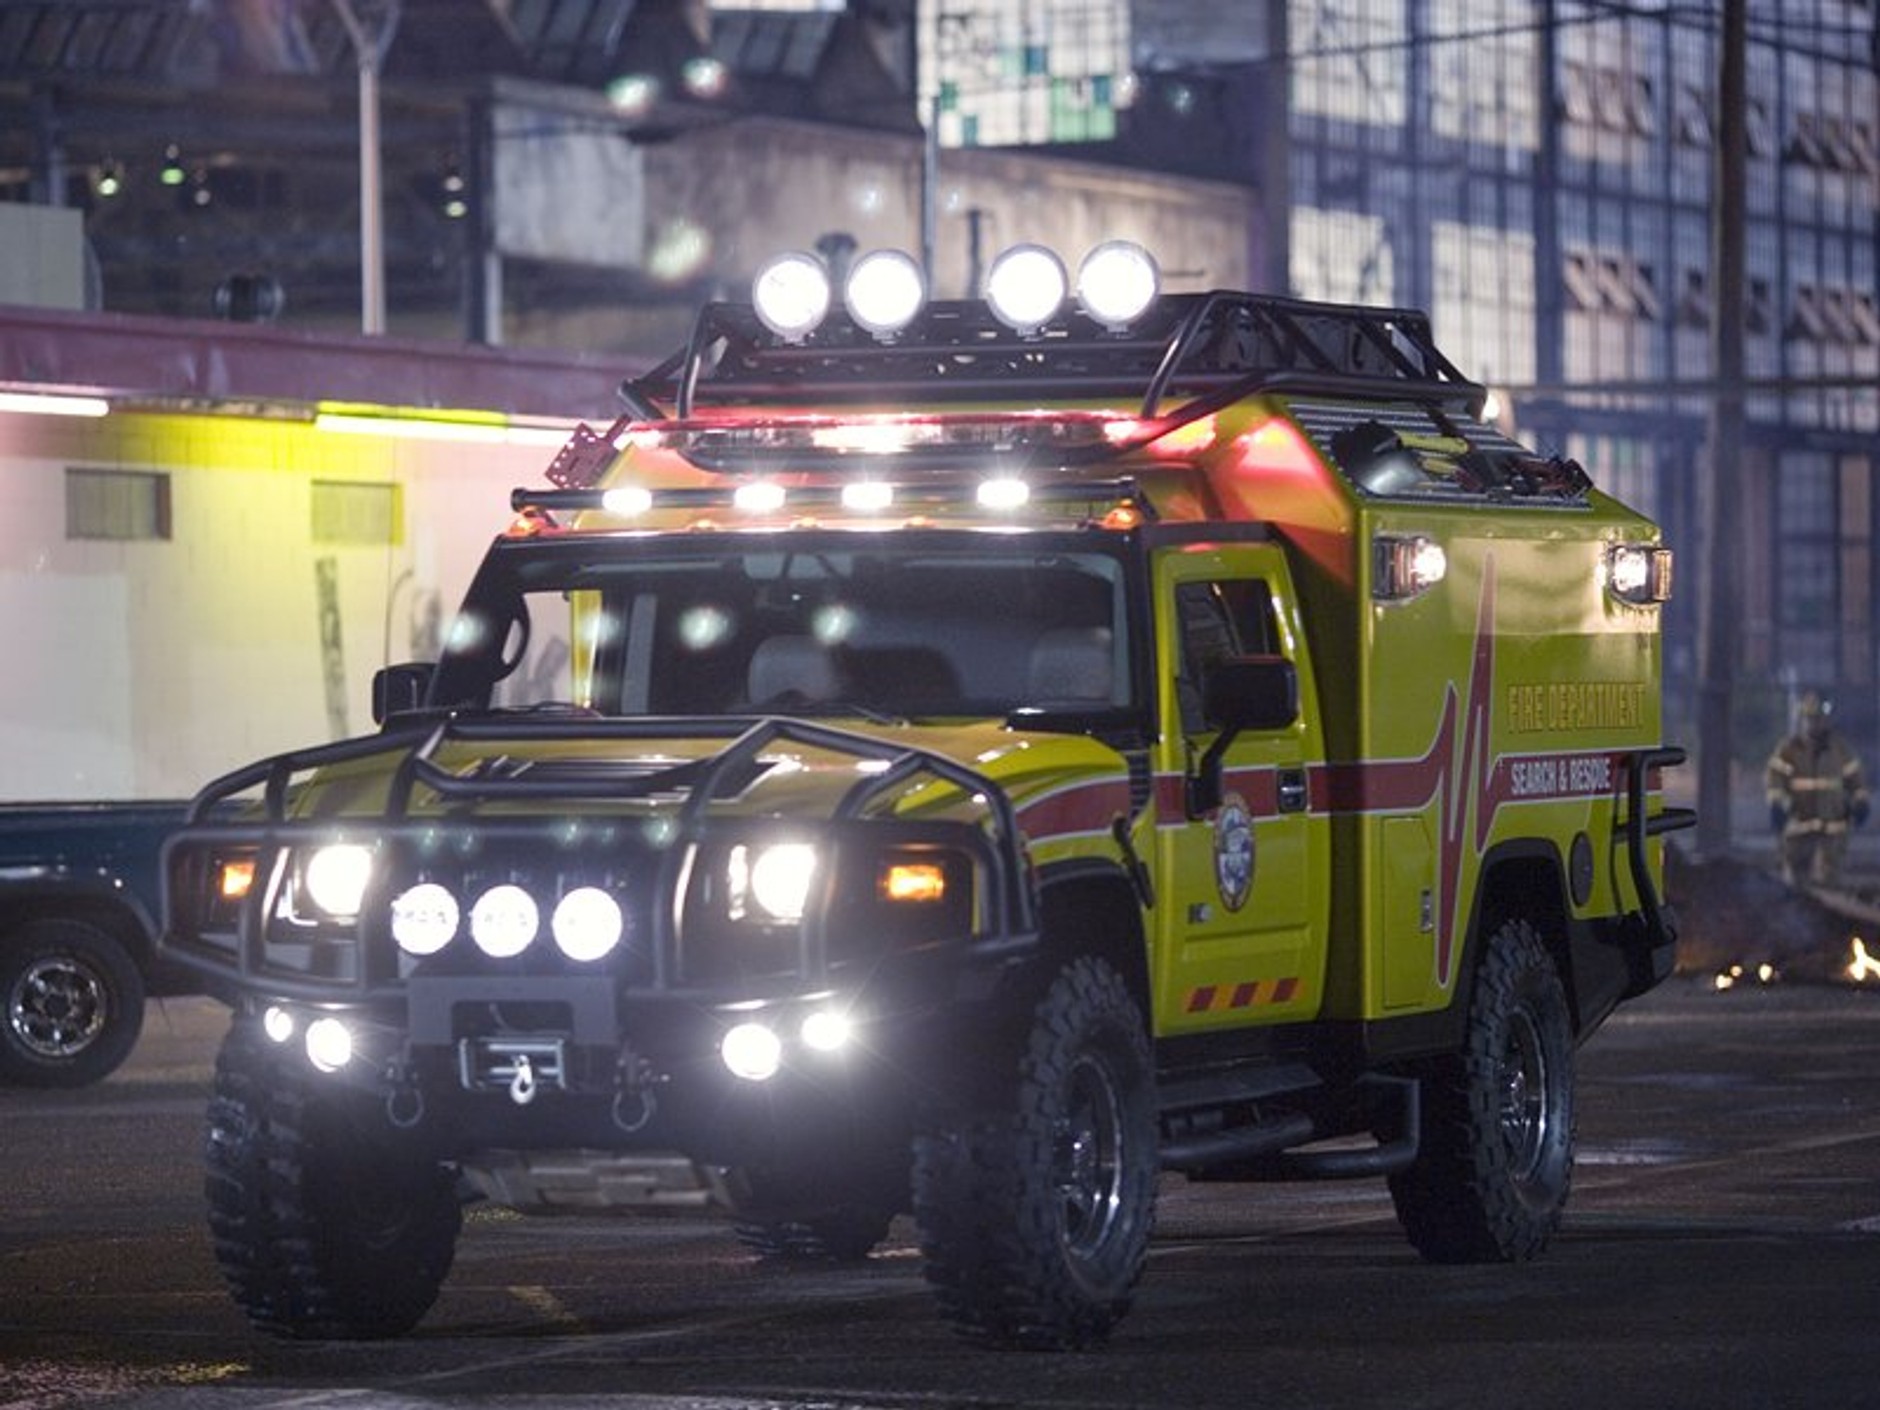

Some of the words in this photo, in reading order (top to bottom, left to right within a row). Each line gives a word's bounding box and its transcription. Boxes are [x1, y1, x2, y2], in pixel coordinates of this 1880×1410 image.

[1507, 684, 1544, 733] FIRE
[1549, 682, 1645, 731] DEPARTMENT
[1511, 761, 1556, 796] SEARCH
[1559, 760, 1568, 791] &
[1570, 757, 1611, 791] RESCUE
